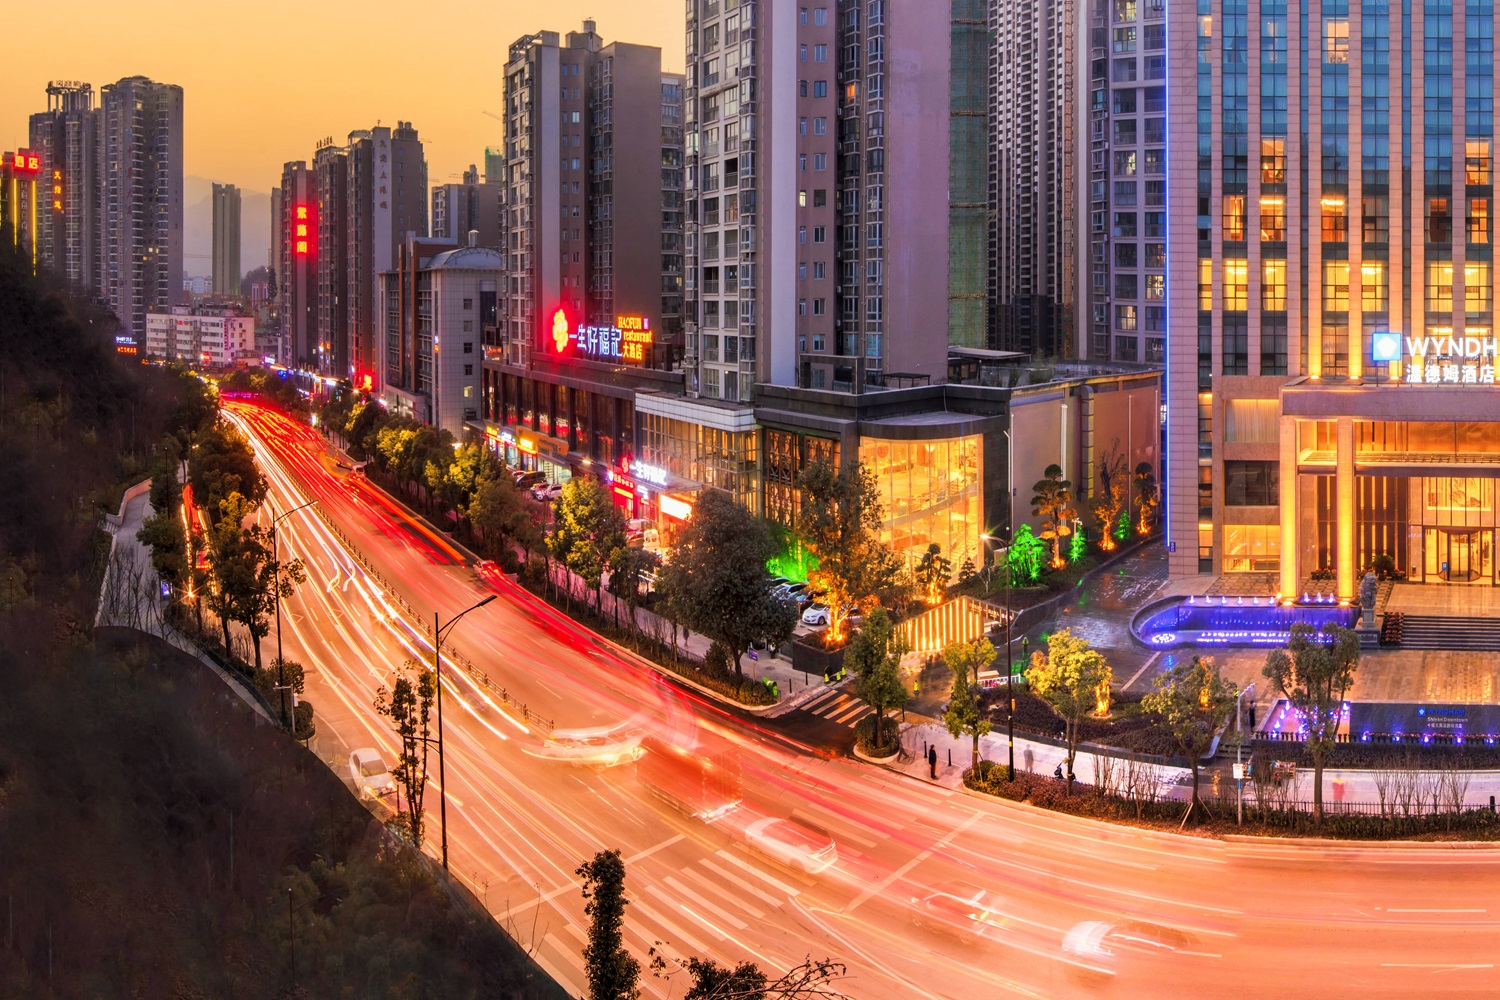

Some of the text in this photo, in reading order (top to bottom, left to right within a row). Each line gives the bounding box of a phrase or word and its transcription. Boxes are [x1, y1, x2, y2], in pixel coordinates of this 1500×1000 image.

[623, 330, 652, 343] restaurant
[622, 342, 643, 360] 大酒店
[1428, 708, 1465, 716] WYNDHAM
